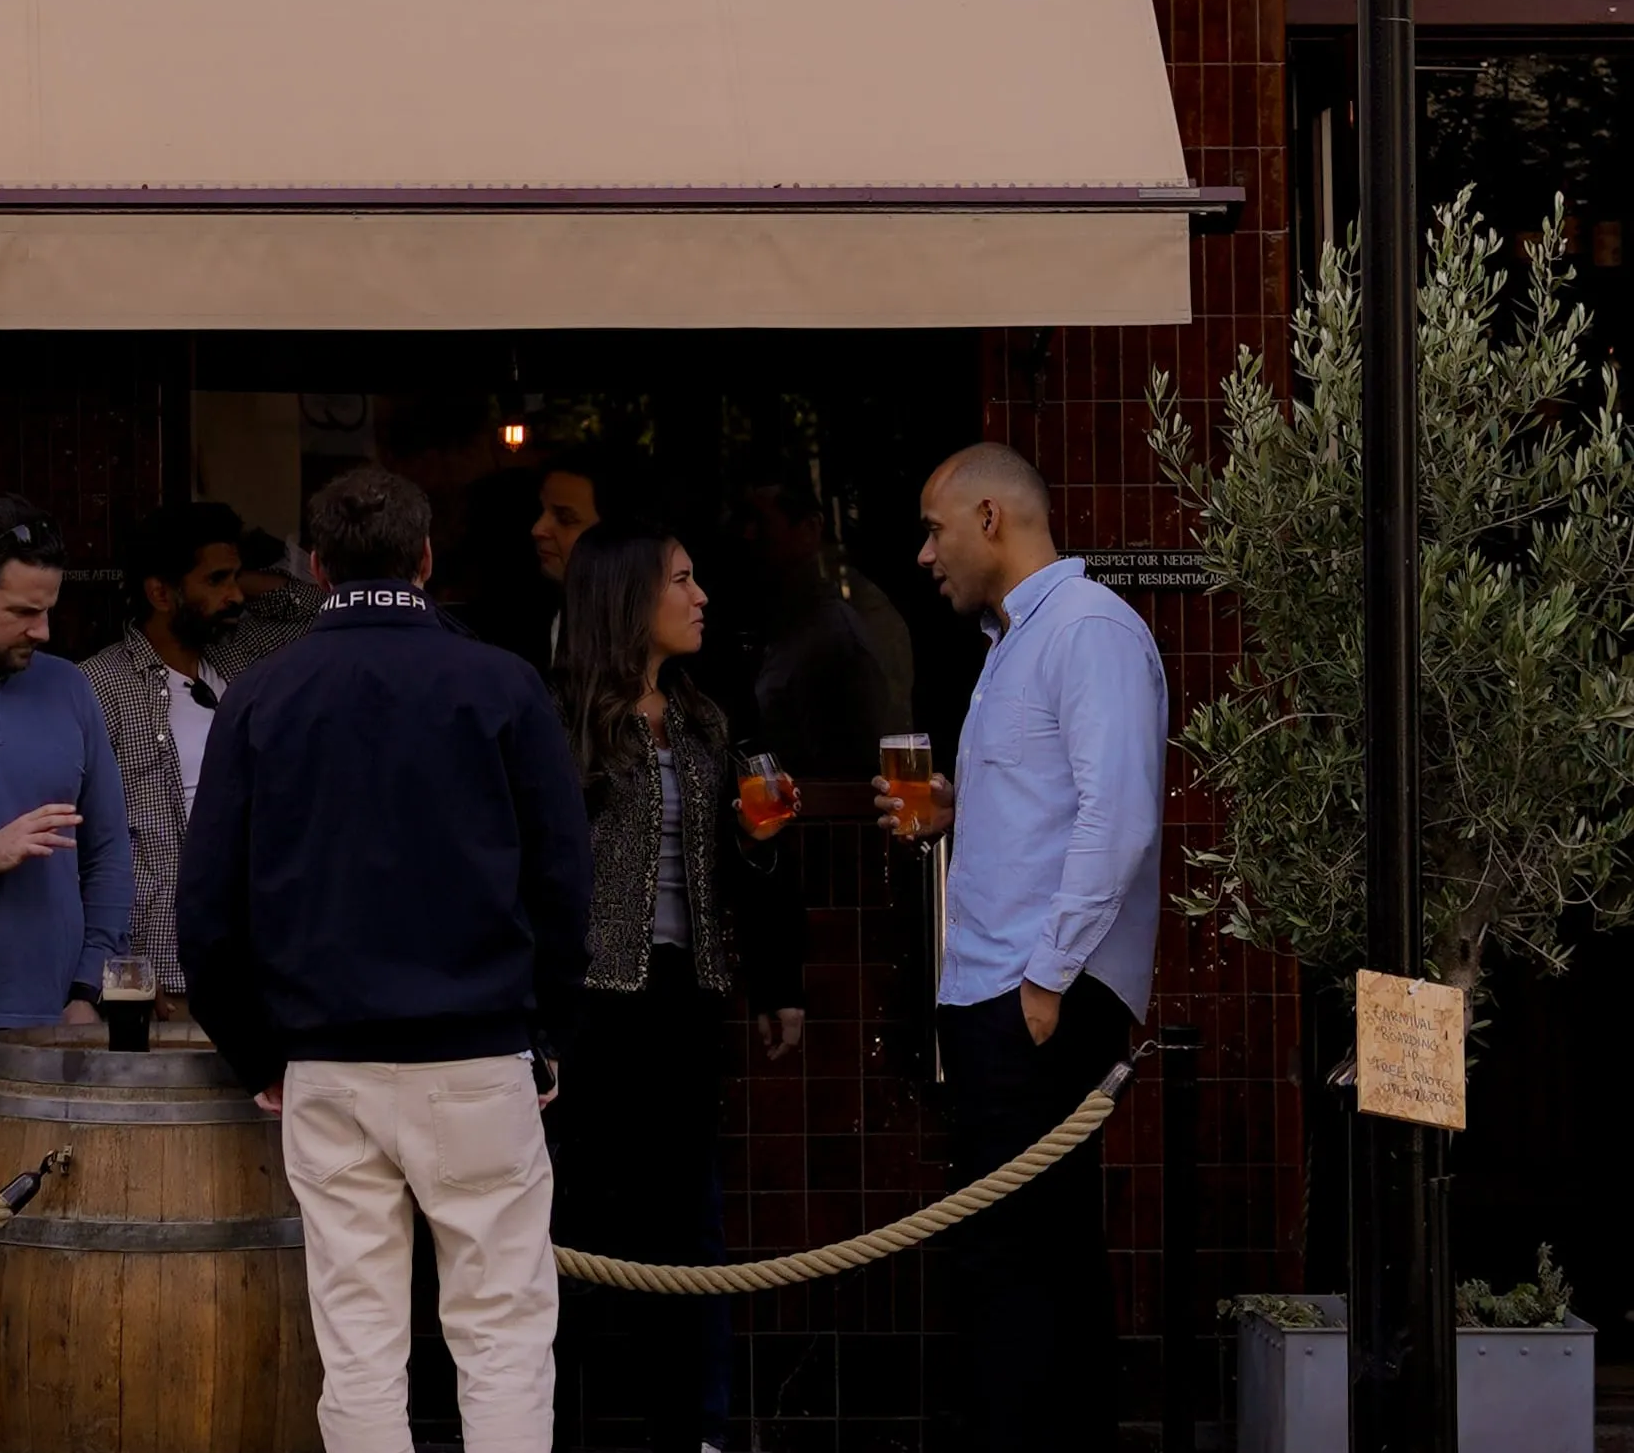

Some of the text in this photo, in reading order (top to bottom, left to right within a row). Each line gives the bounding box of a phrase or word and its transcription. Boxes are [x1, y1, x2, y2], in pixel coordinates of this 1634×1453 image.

[1086, 555, 1136, 566] RESPECT
[1137, 555, 1159, 566] OUR
[1097, 573, 1134, 585] QUIET
[1138, 573, 1208, 585] RESIDENTIAL
[1374, 1004, 1438, 1031] CARNIVAL
[1381, 1026, 1438, 1052] BOARDING
